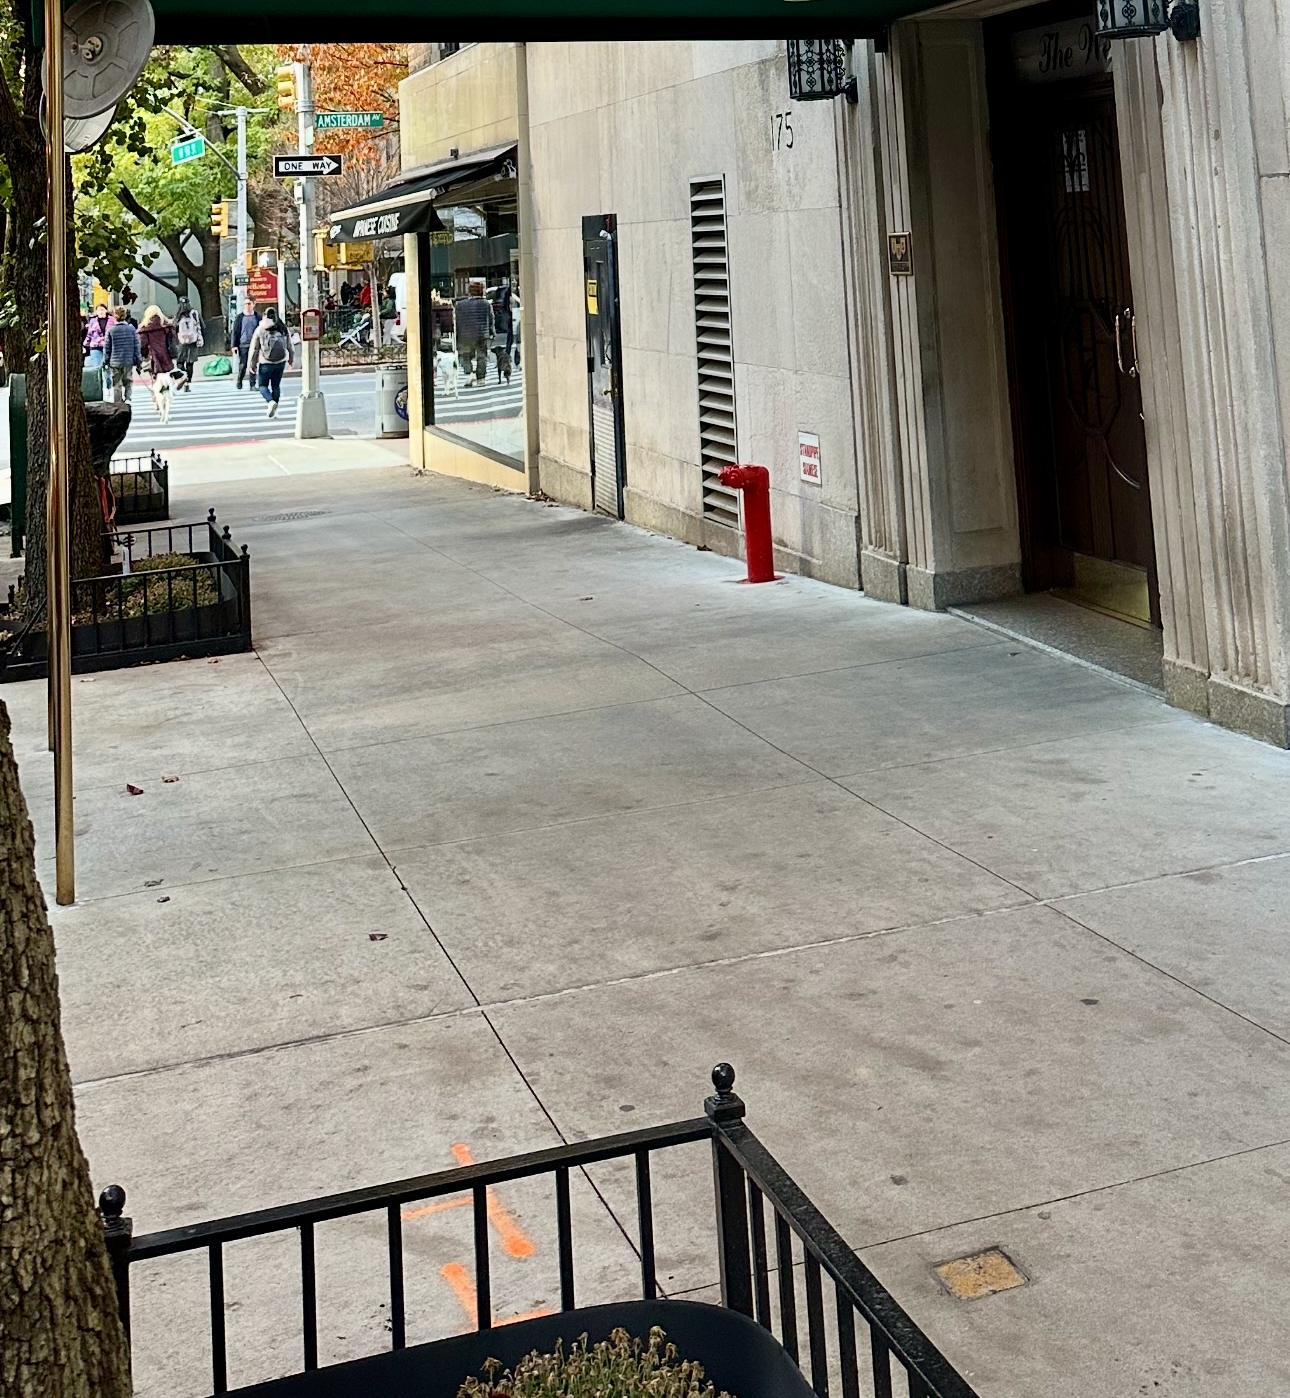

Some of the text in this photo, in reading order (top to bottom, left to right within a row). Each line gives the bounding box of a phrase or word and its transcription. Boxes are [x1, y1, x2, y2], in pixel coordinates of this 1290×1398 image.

[1039, 32, 1074, 73] The
[317, 113, 381, 128] AMSTERDAM AV
[770, 111, 794, 151] 175
[284, 161, 332, 171] ONE WAY
